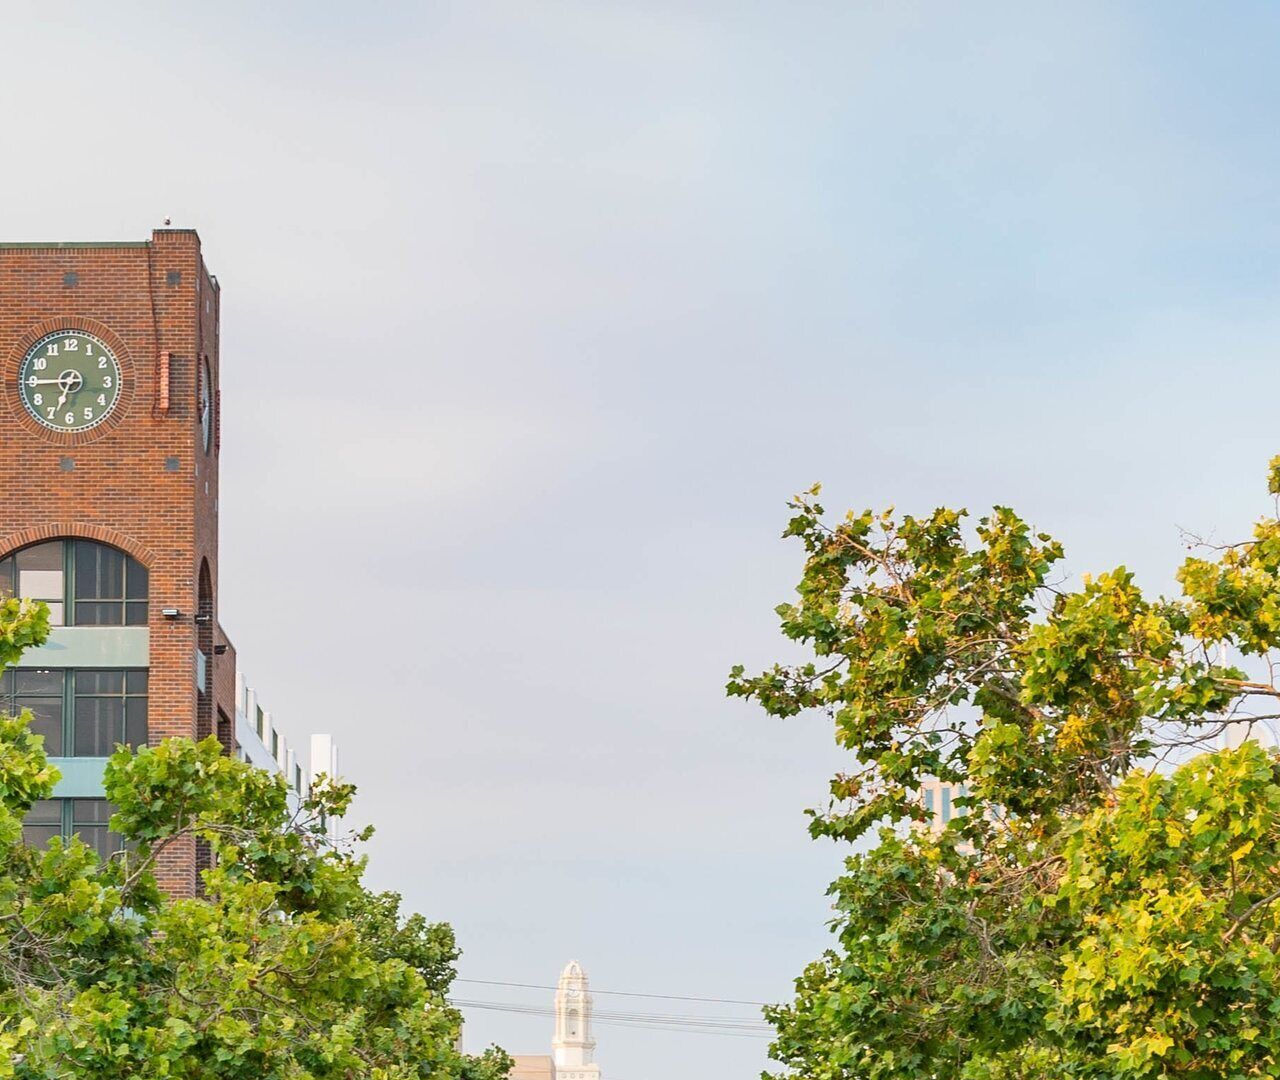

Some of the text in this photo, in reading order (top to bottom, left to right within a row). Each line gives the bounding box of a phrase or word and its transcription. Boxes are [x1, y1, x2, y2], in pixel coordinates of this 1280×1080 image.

[47, 343, 59, 356] 11
[64, 338, 78, 351] 12
[85, 344, 93, 356] 1
[32, 357, 47, 370] 10
[98, 356, 107, 369] 2
[103, 376, 112, 388] 3
[33, 393, 43, 405] 8
[97, 393, 106, 405] 4
[47, 407, 56, 420] 7
[65, 412, 74, 424] 6
[84, 407, 93, 420] 5
